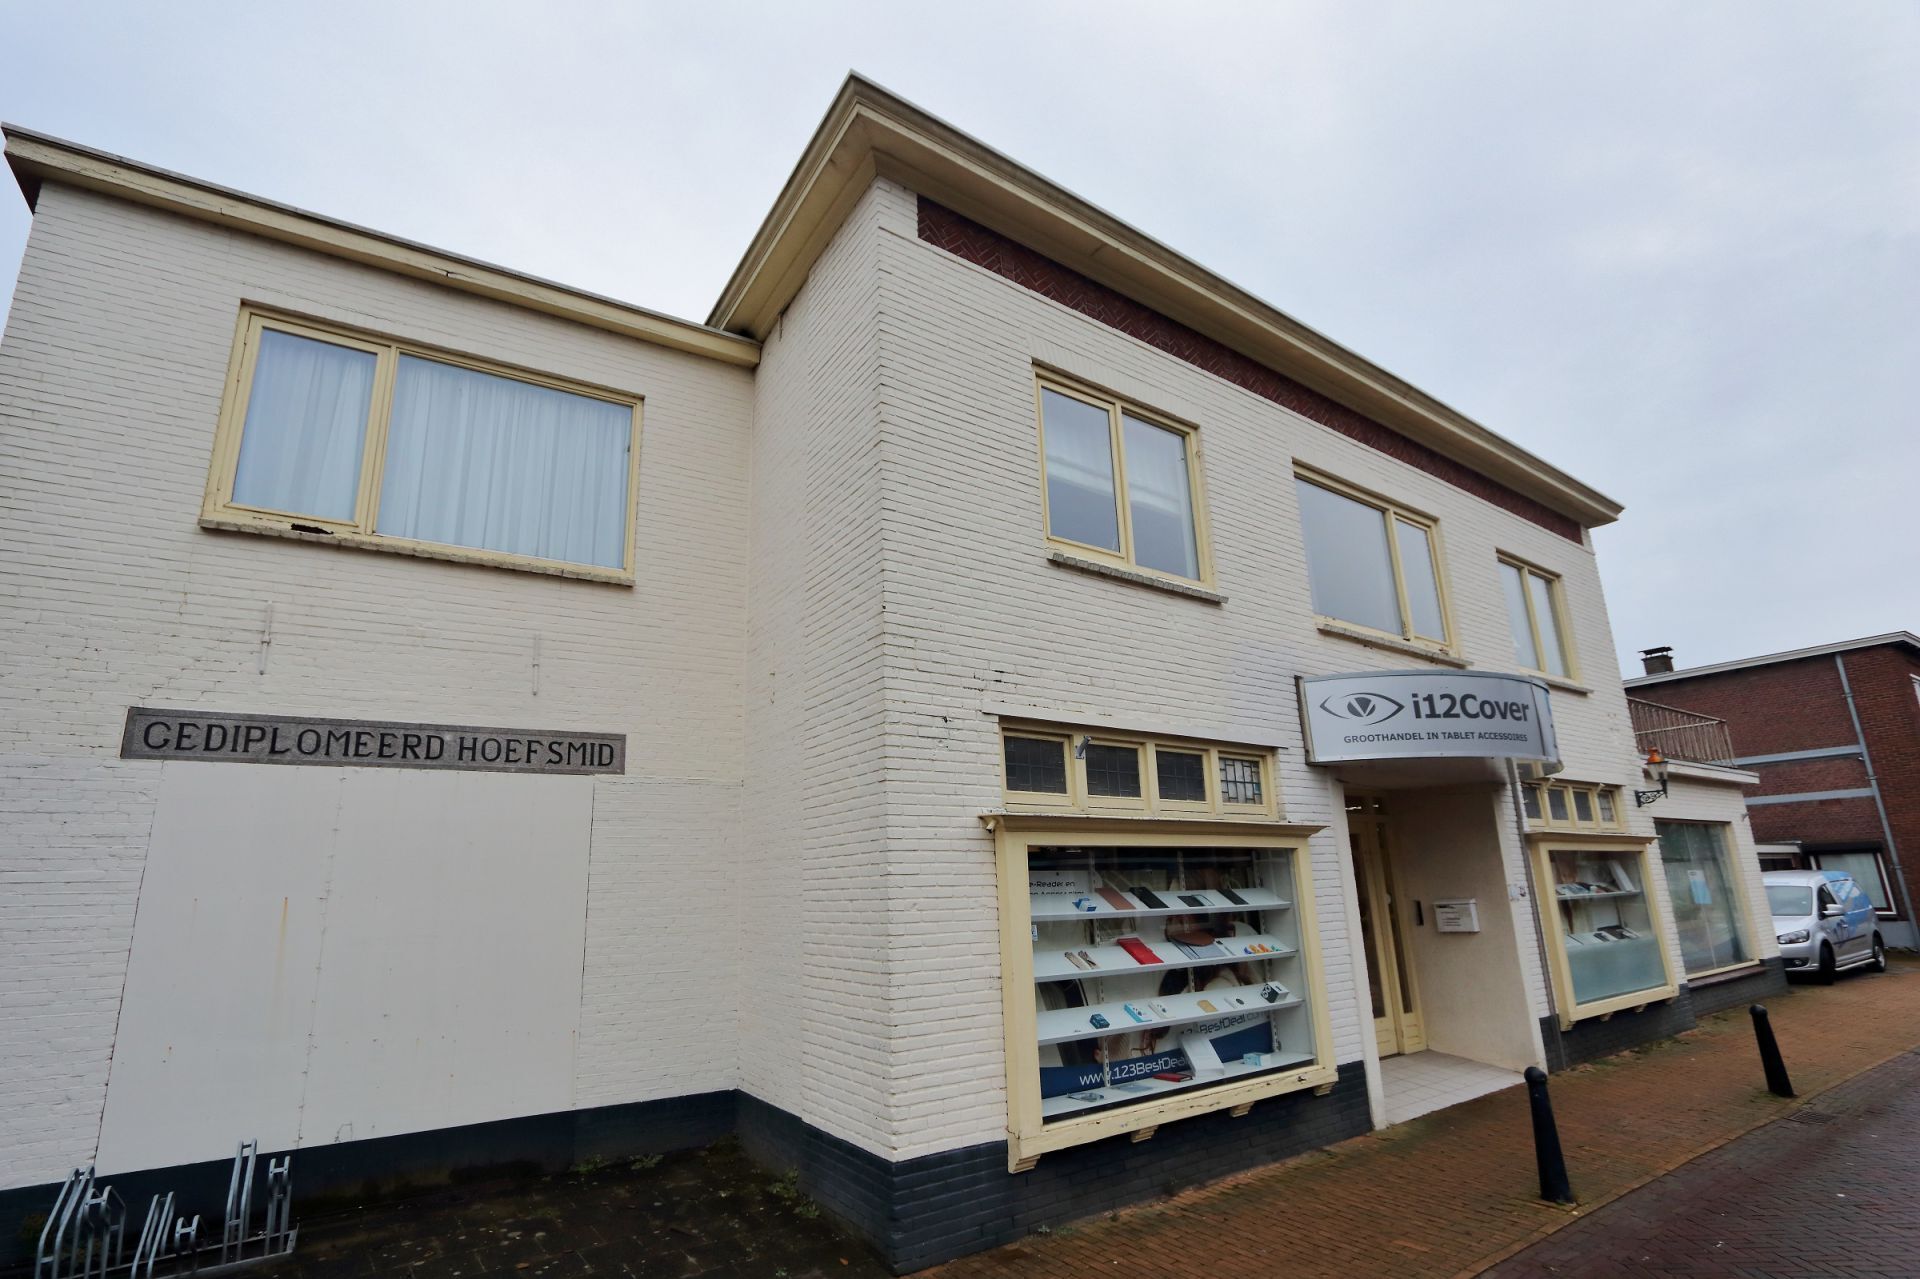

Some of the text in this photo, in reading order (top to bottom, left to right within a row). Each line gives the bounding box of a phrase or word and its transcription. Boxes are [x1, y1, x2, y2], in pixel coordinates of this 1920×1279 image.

[1412, 693, 1529, 722] i12Cover
[143, 721, 614, 766] GEDIPLOMEERD HOEFSMID
[1343, 731, 1528, 744] GROOTHANDEL IN TABLET ACCESSOIRES
